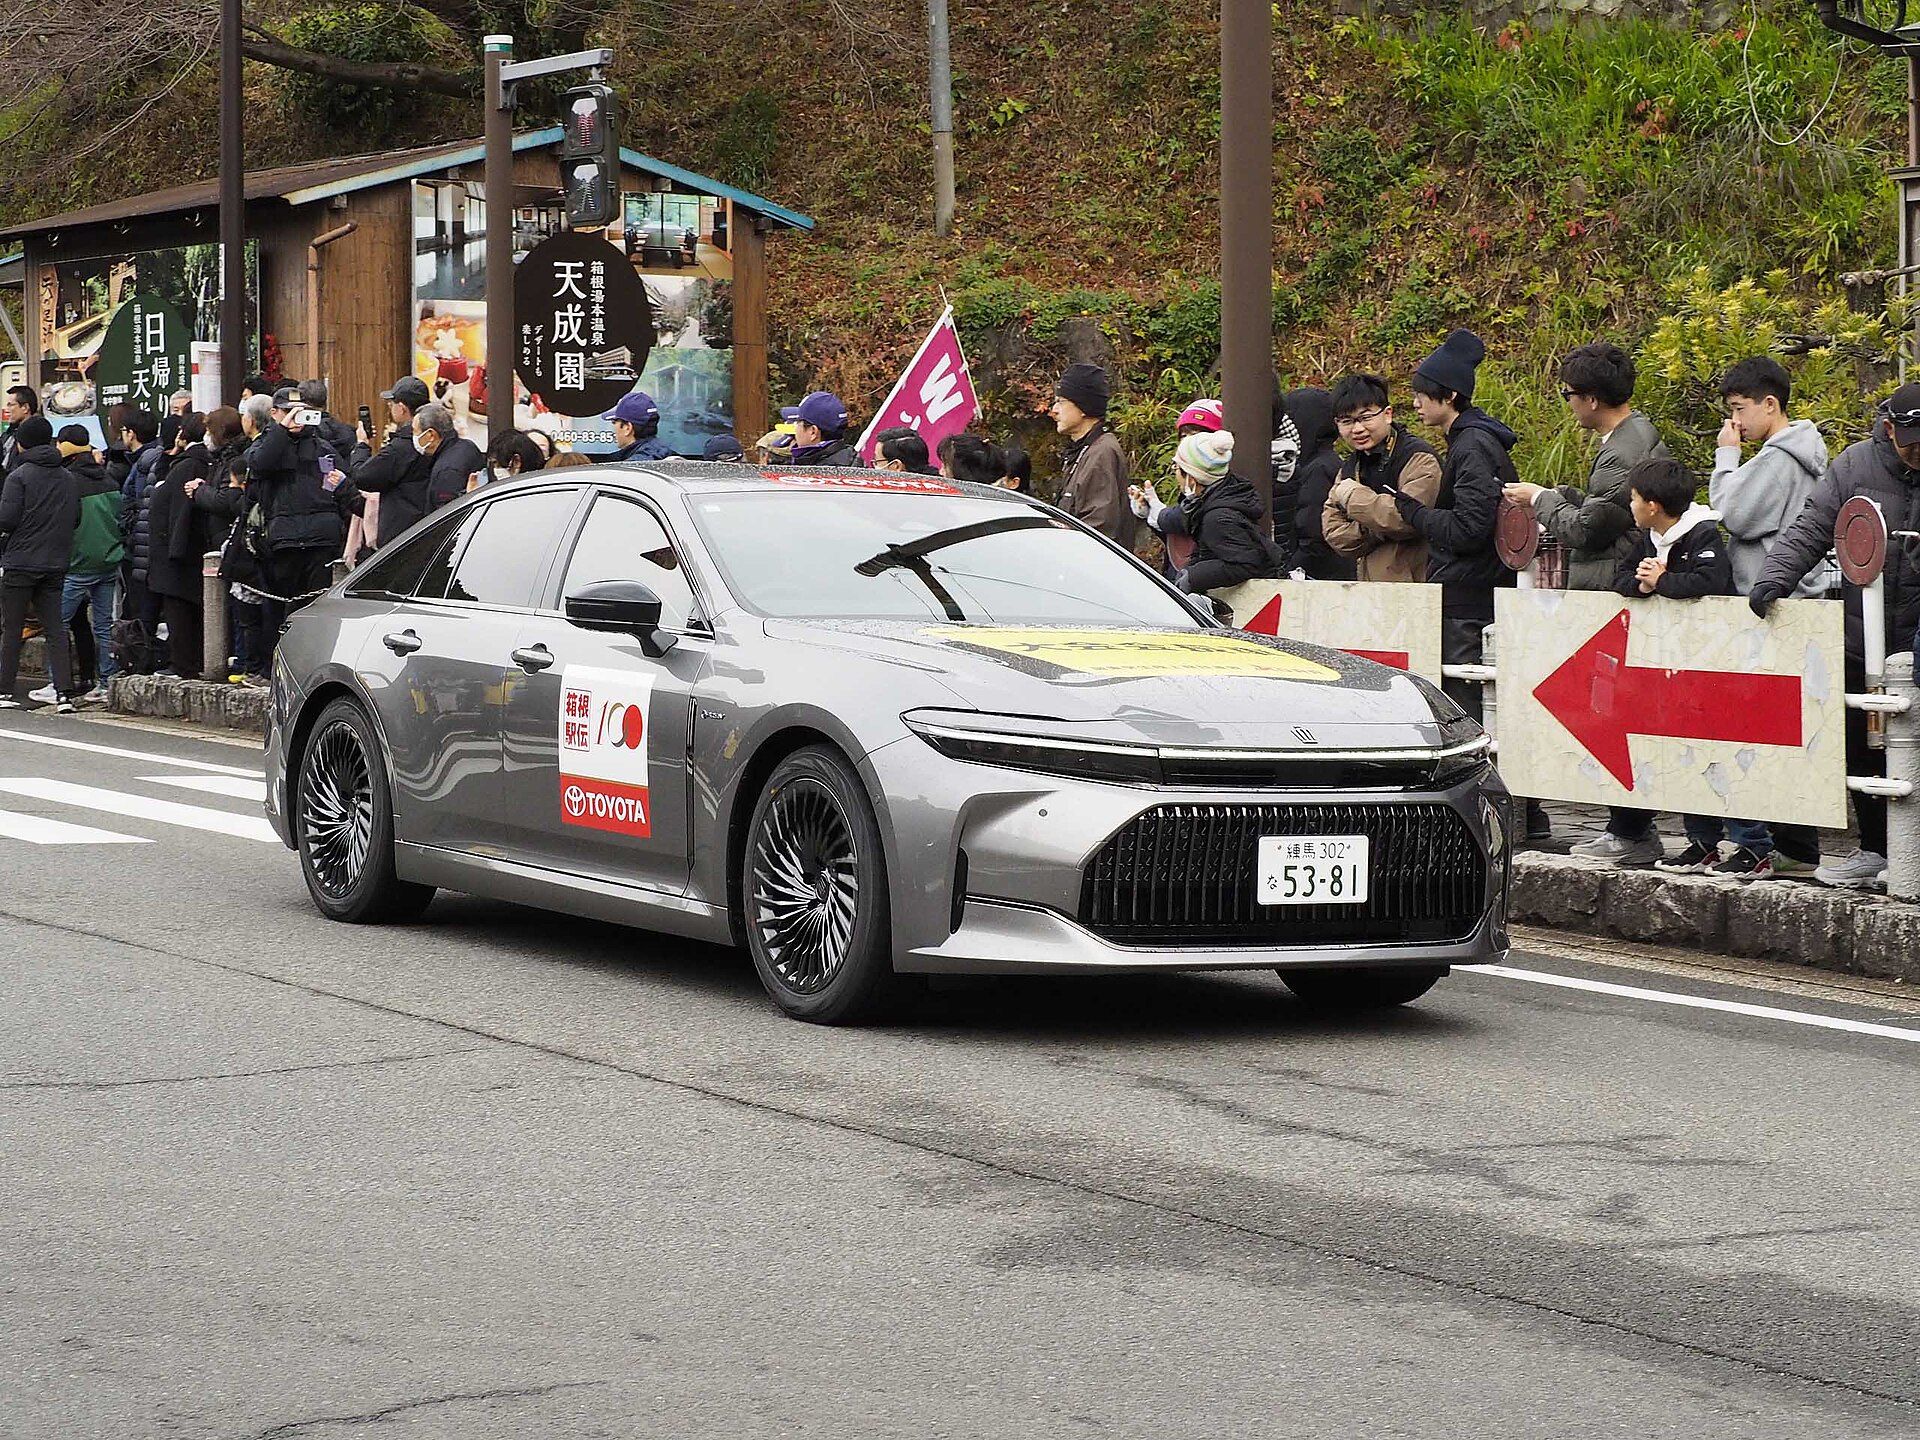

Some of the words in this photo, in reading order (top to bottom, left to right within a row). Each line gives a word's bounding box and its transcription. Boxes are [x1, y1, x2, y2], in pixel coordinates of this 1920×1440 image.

[589, 260, 606, 346] 箱根湯本温泉
[551, 260, 588, 391] 天成園
[521, 323, 532, 366] 楽しめる
[533, 324, 544, 378] デザートも
[566, 692, 589, 718] 箱根
[565, 721, 588, 748] 駅伝
[585, 791, 647, 825] TOYOTA
[1286, 842, 1315, 860] 練馬
[1319, 842, 1345, 860] 302
[1266, 874, 1278, 890] な
[1283, 864, 1357, 898] 53-81
